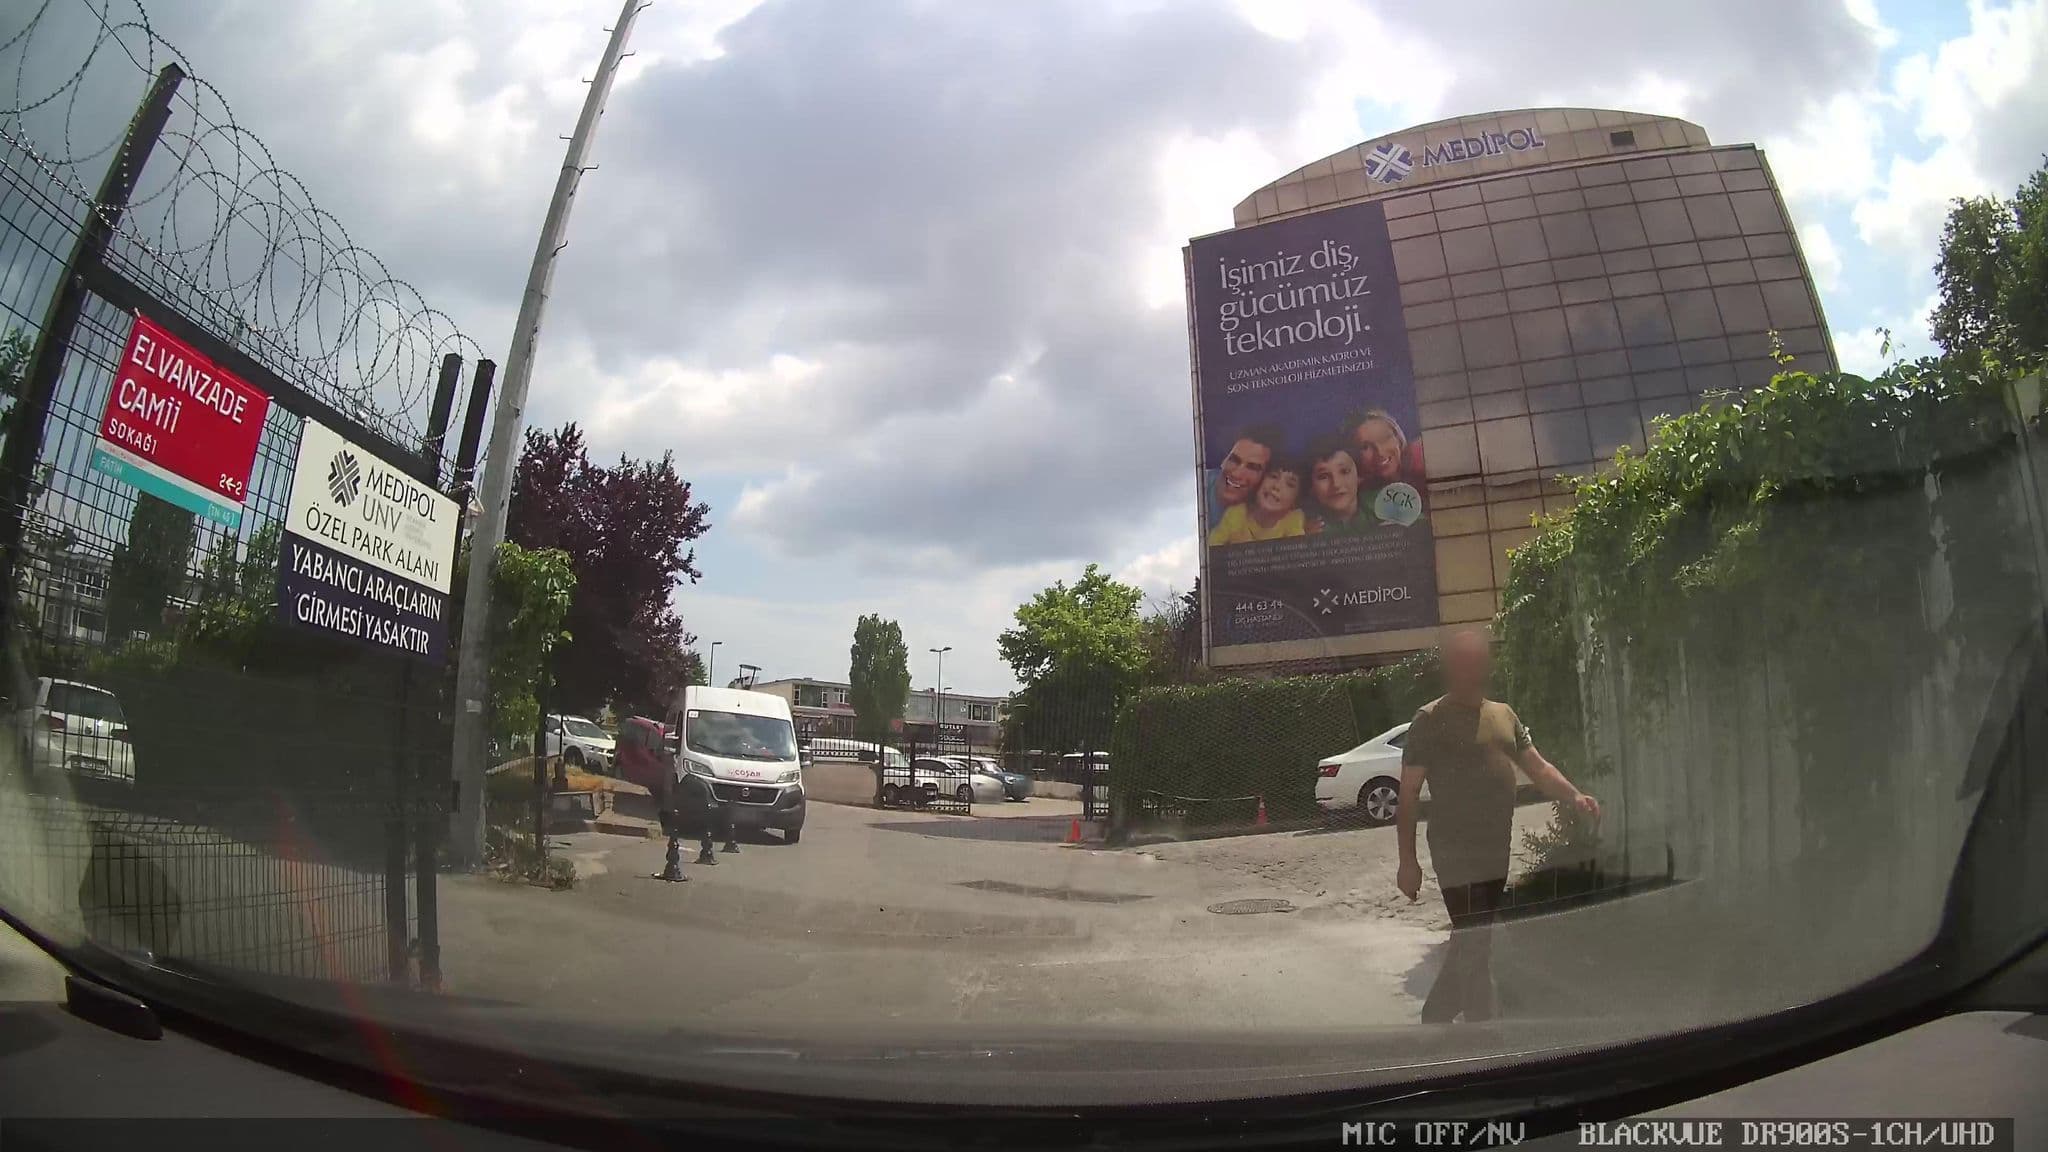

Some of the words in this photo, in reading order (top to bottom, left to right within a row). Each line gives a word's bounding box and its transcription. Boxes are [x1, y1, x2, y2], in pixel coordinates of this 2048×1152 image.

[1423, 128, 1545, 168] MEDİPOL
[1219, 251, 1304, 295] İşimiz
[1310, 240, 1359, 272] diş,
[1220, 272, 1371, 332] gücümüz
[1224, 304, 1371, 356] teknoloji.
[131, 334, 248, 425] ELVANZADE
[1227, 382, 1249, 394] SON
[1229, 366, 1268, 381] UZMAN
[1321, 350, 1358, 364] KADRO
[118, 378, 182, 434] CAMİİ
[108, 417, 158, 455] SOKAĞI
[362, 494, 403, 533] UNV
[366, 466, 436, 523] MEDİPOL
[1383, 489, 1417, 509] SGK
[305, 501, 348, 546] ÖZEL
[351, 532, 393, 564] PARK
[396, 550, 439, 583] ALANI
[292, 544, 362, 594] YABANCI
[365, 580, 442, 624] ARAÇLARIN
[1256, 600, 1268, 611] 63
[1343, 586, 1412, 606] MEDİPOL
[297, 590, 365, 638] GİRMESİ
[365, 616, 430, 655] YASAKTIR
